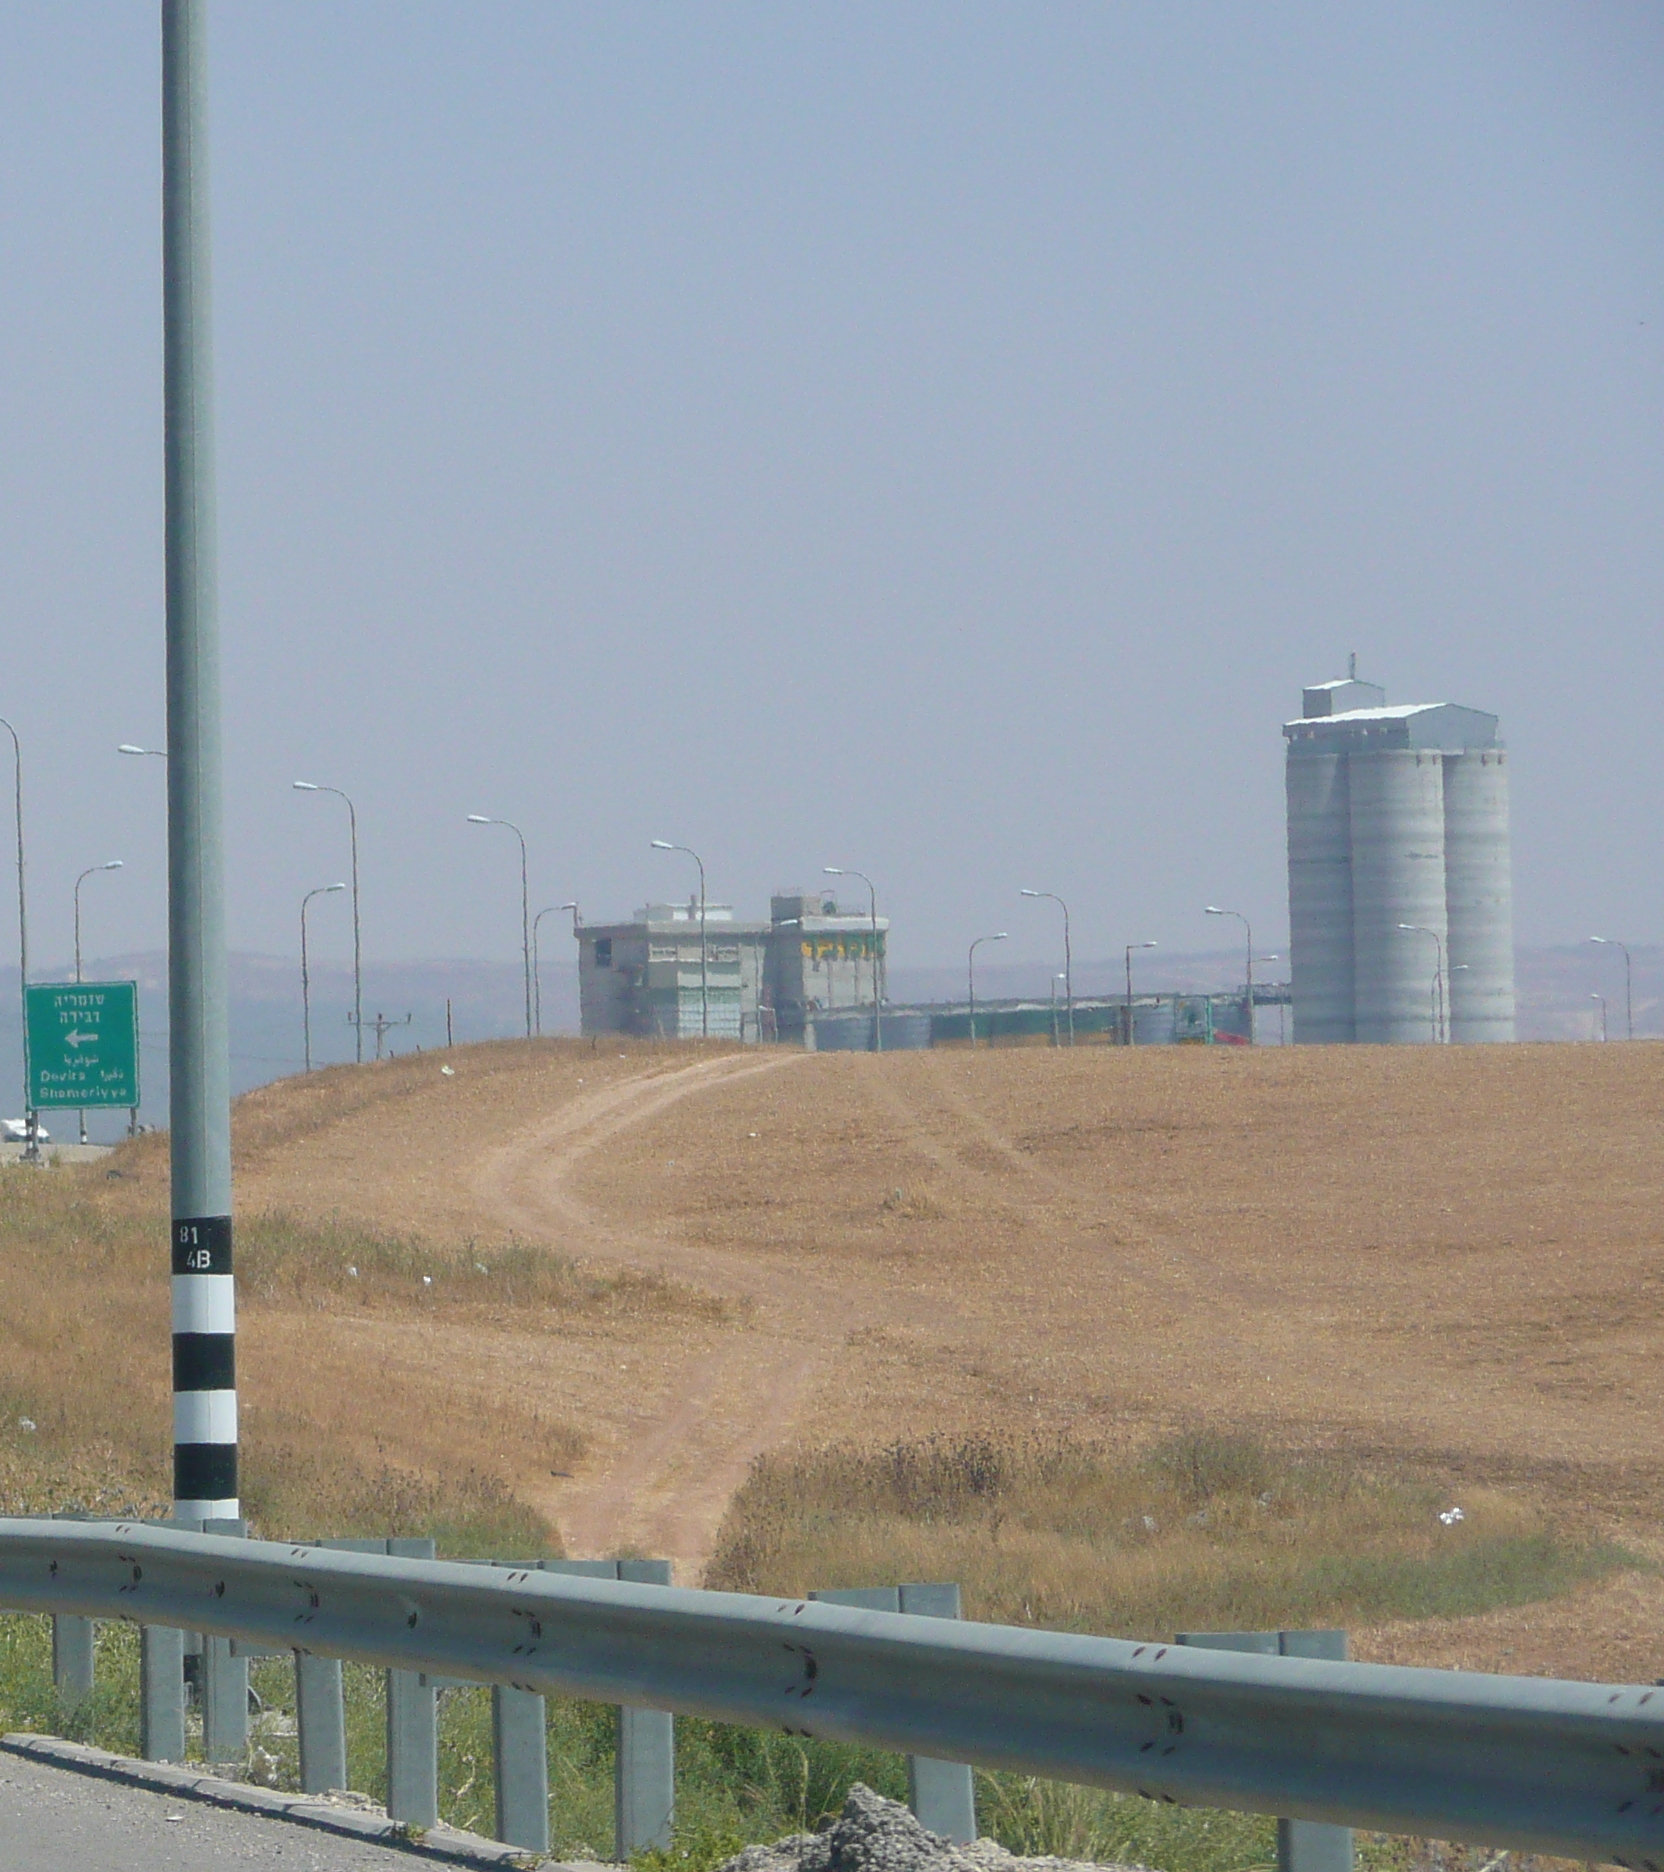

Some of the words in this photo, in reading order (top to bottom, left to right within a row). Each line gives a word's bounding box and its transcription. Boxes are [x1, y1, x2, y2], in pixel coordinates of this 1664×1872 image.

[54, 994, 105, 1007] שומריה
[180, 1225, 198, 1245] 81
[186, 1249, 211, 1269] 4B
